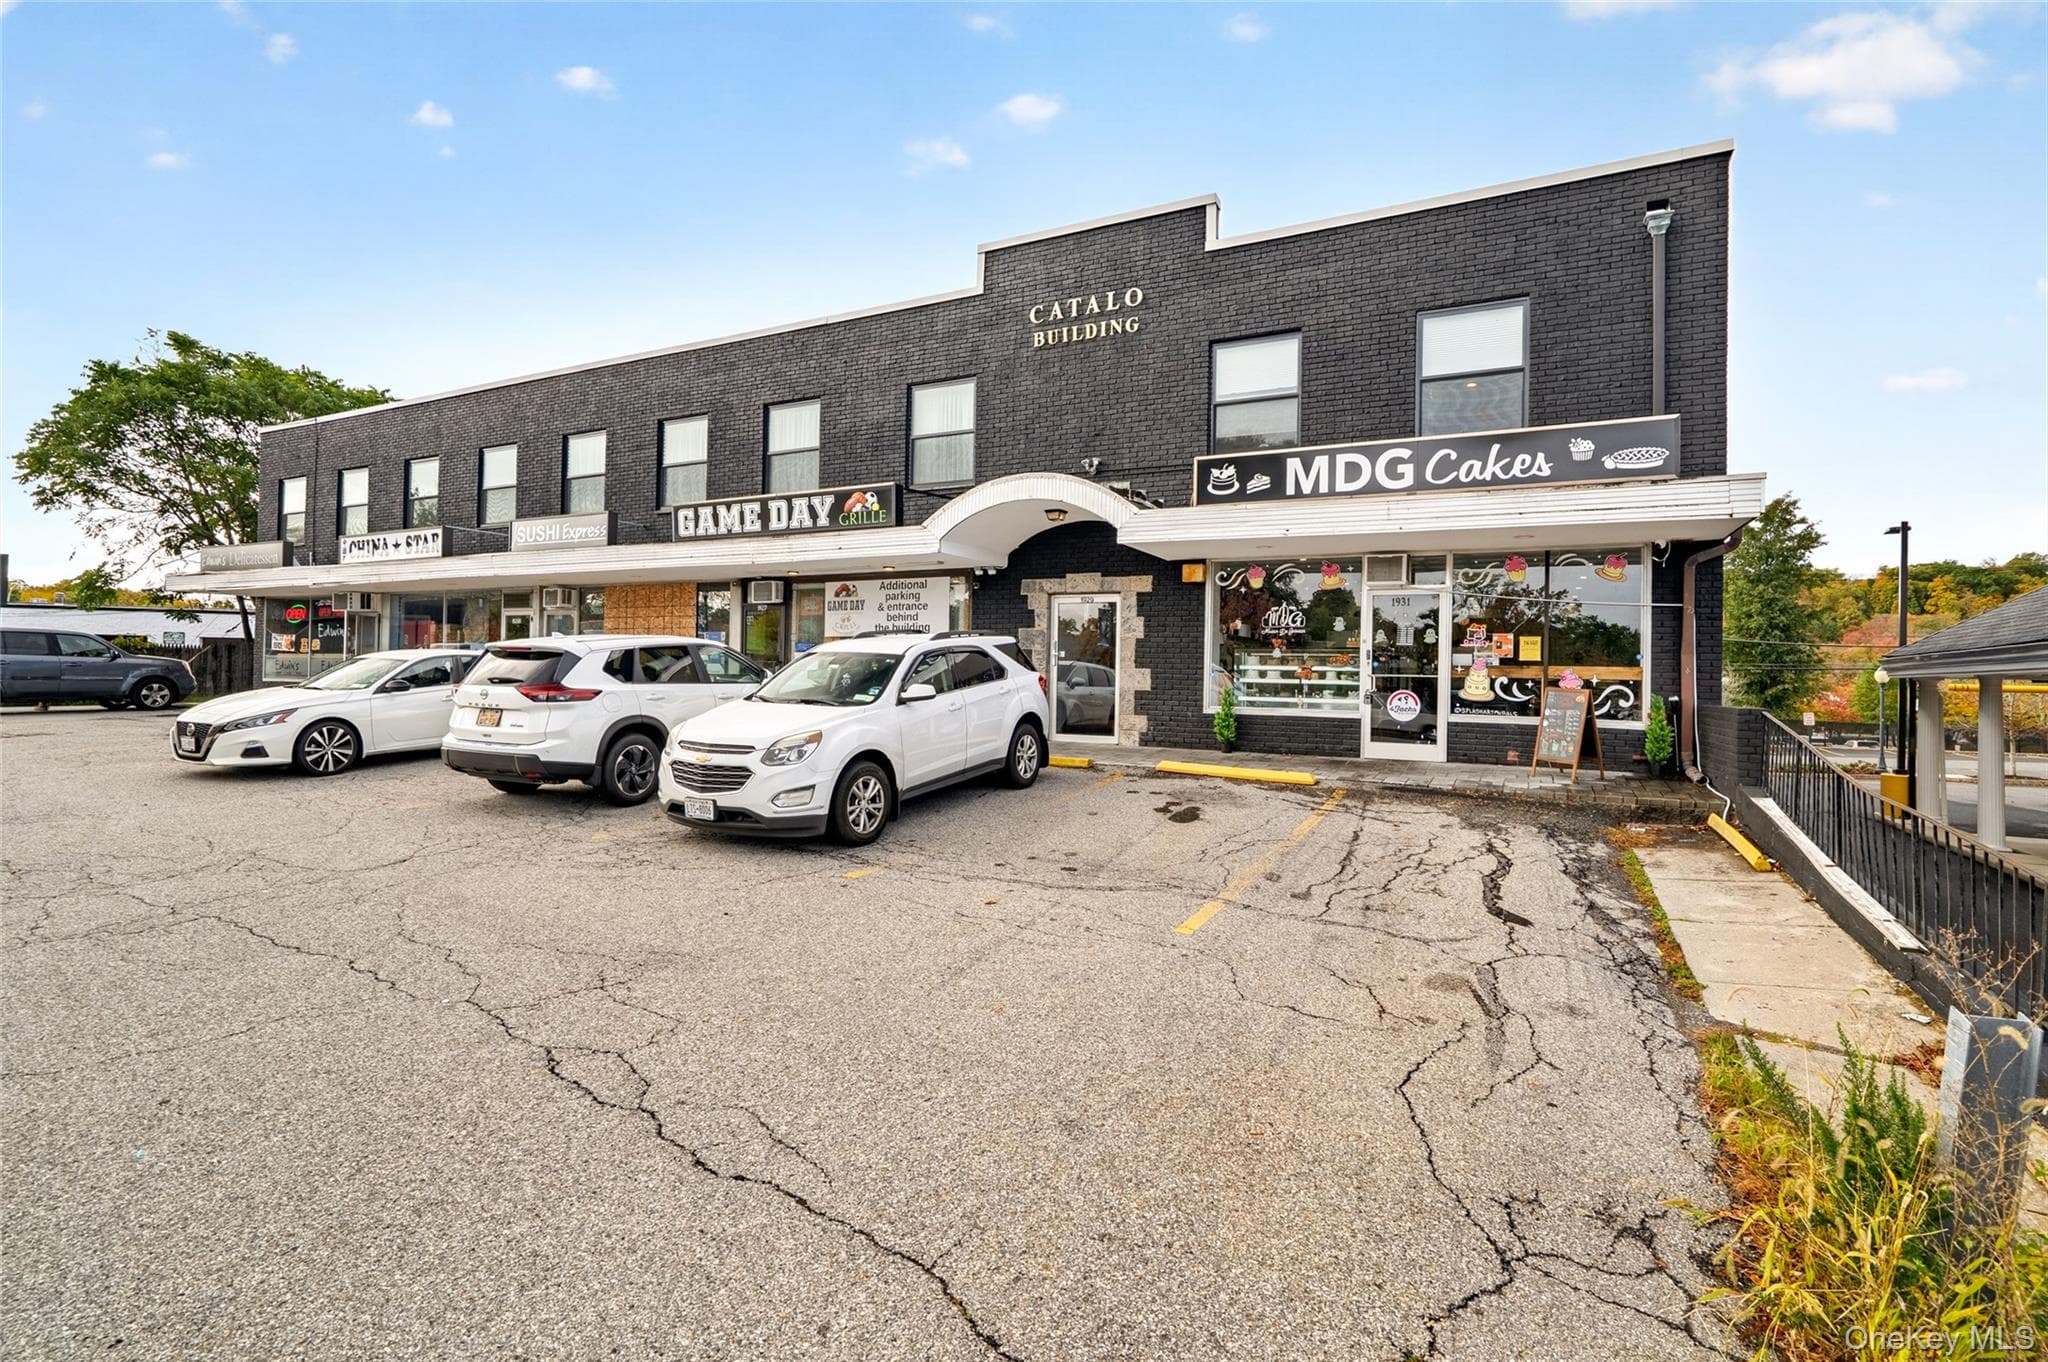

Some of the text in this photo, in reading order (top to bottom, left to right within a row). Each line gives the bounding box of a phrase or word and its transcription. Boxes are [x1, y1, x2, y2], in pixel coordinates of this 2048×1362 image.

[1029, 287, 1143, 324] CATALO
[1033, 316, 1140, 348] BUILDING
[1285, 443, 1553, 496] MDG Cakes
[677, 494, 834, 538] GAME DAY
[838, 509, 887, 526] GRILLE
[516, 523, 607, 543] SUSHI Express
[349, 537, 388, 556] CHINA
[879, 579, 928, 591] Additional
[885, 592, 921, 603] parking
[1391, 597, 1410, 607] 1931
[827, 600, 865, 611] GAME DAY
[877, 602, 928, 611] & entrance
[886, 612, 919, 622] behind
[875, 623, 931, 634] the building
